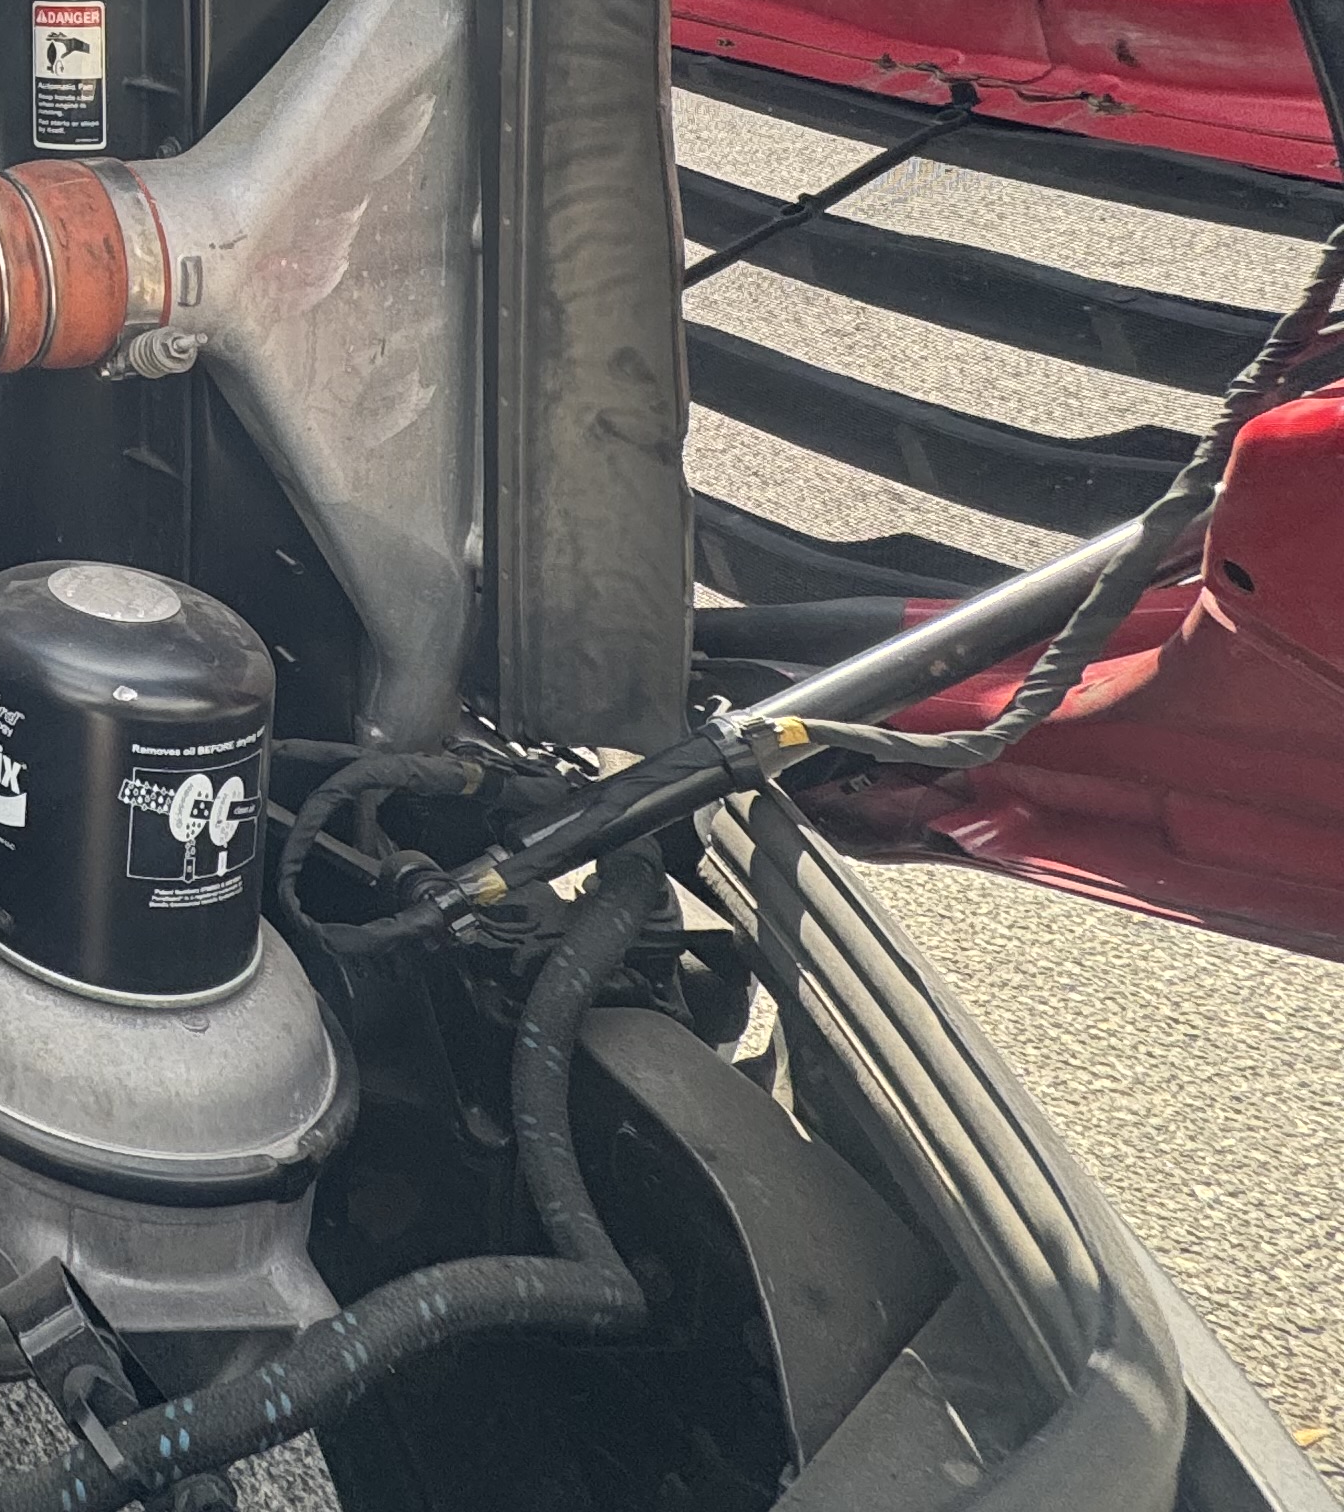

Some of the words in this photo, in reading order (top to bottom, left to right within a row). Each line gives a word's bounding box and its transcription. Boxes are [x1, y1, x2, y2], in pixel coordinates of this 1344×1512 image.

[47, 11, 100, 24] DANGER
[132, 743, 181, 757] Removes
[197, 740, 235, 756] BEFORE
